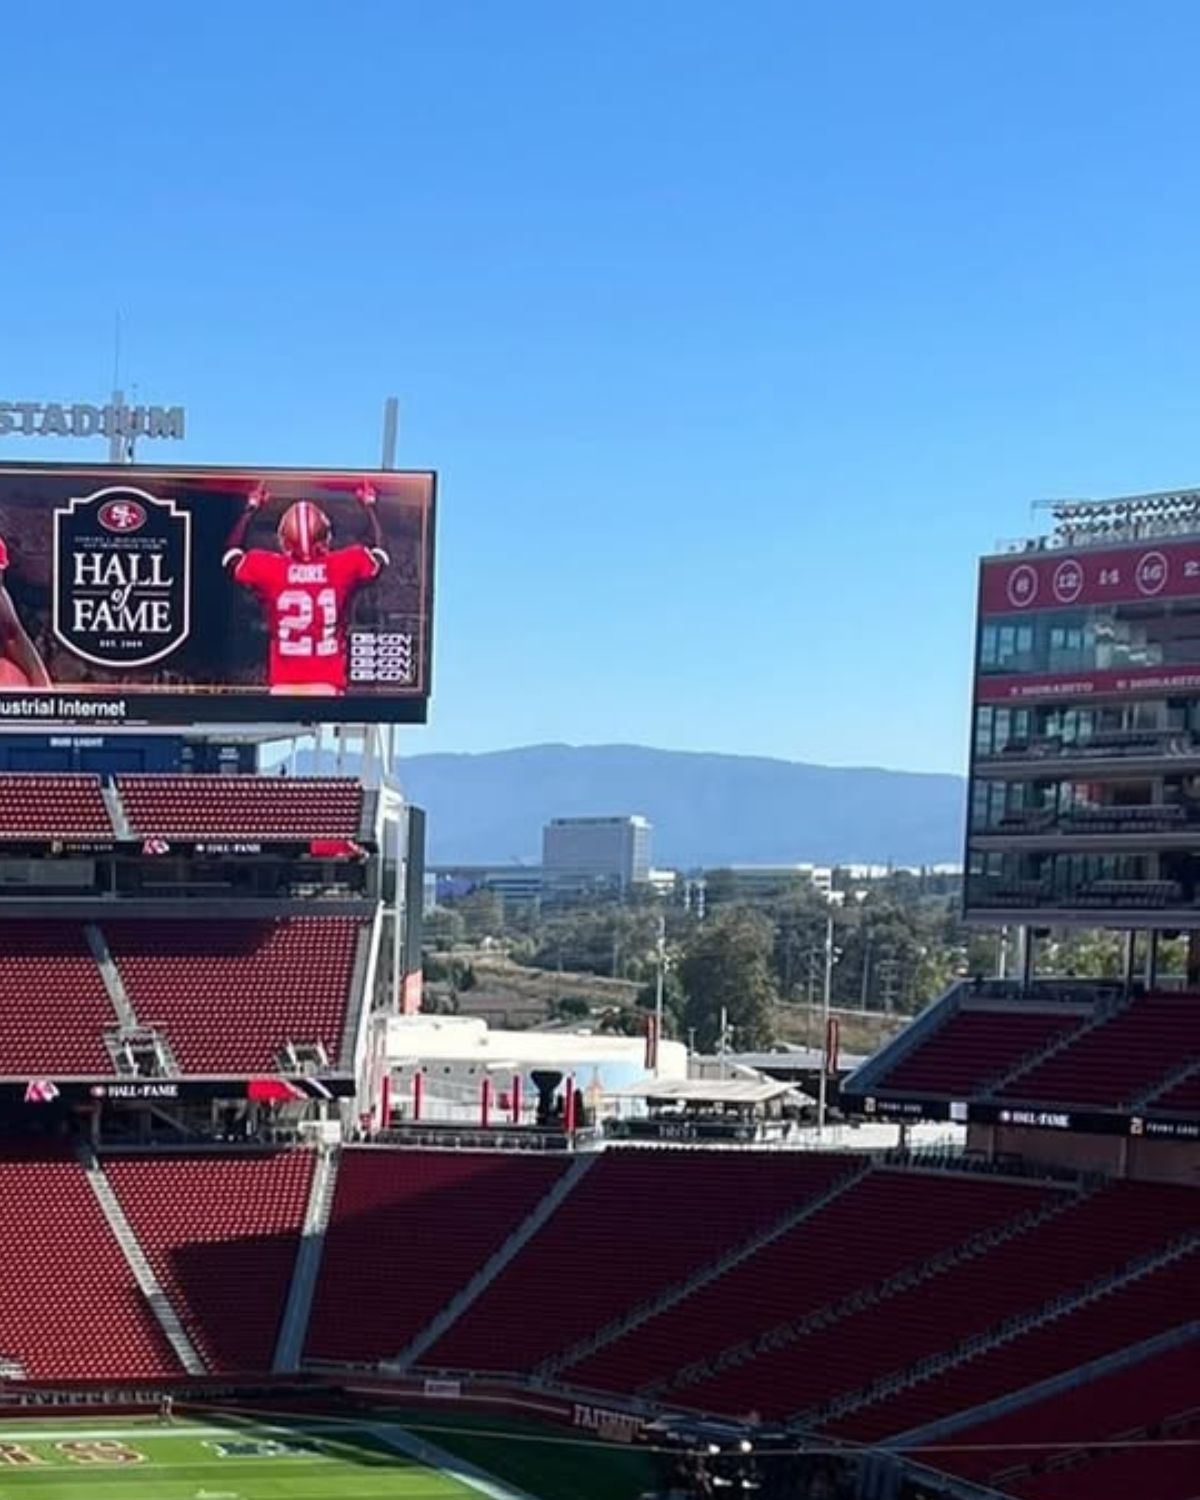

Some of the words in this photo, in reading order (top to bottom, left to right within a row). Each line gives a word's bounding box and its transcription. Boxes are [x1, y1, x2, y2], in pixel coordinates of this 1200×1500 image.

[73, 552, 174, 586] HALL
[110, 583, 133, 611] of
[72, 600, 173, 632] FAME
[276, 589, 339, 657] 21
[58, 700, 126, 716] Internet
